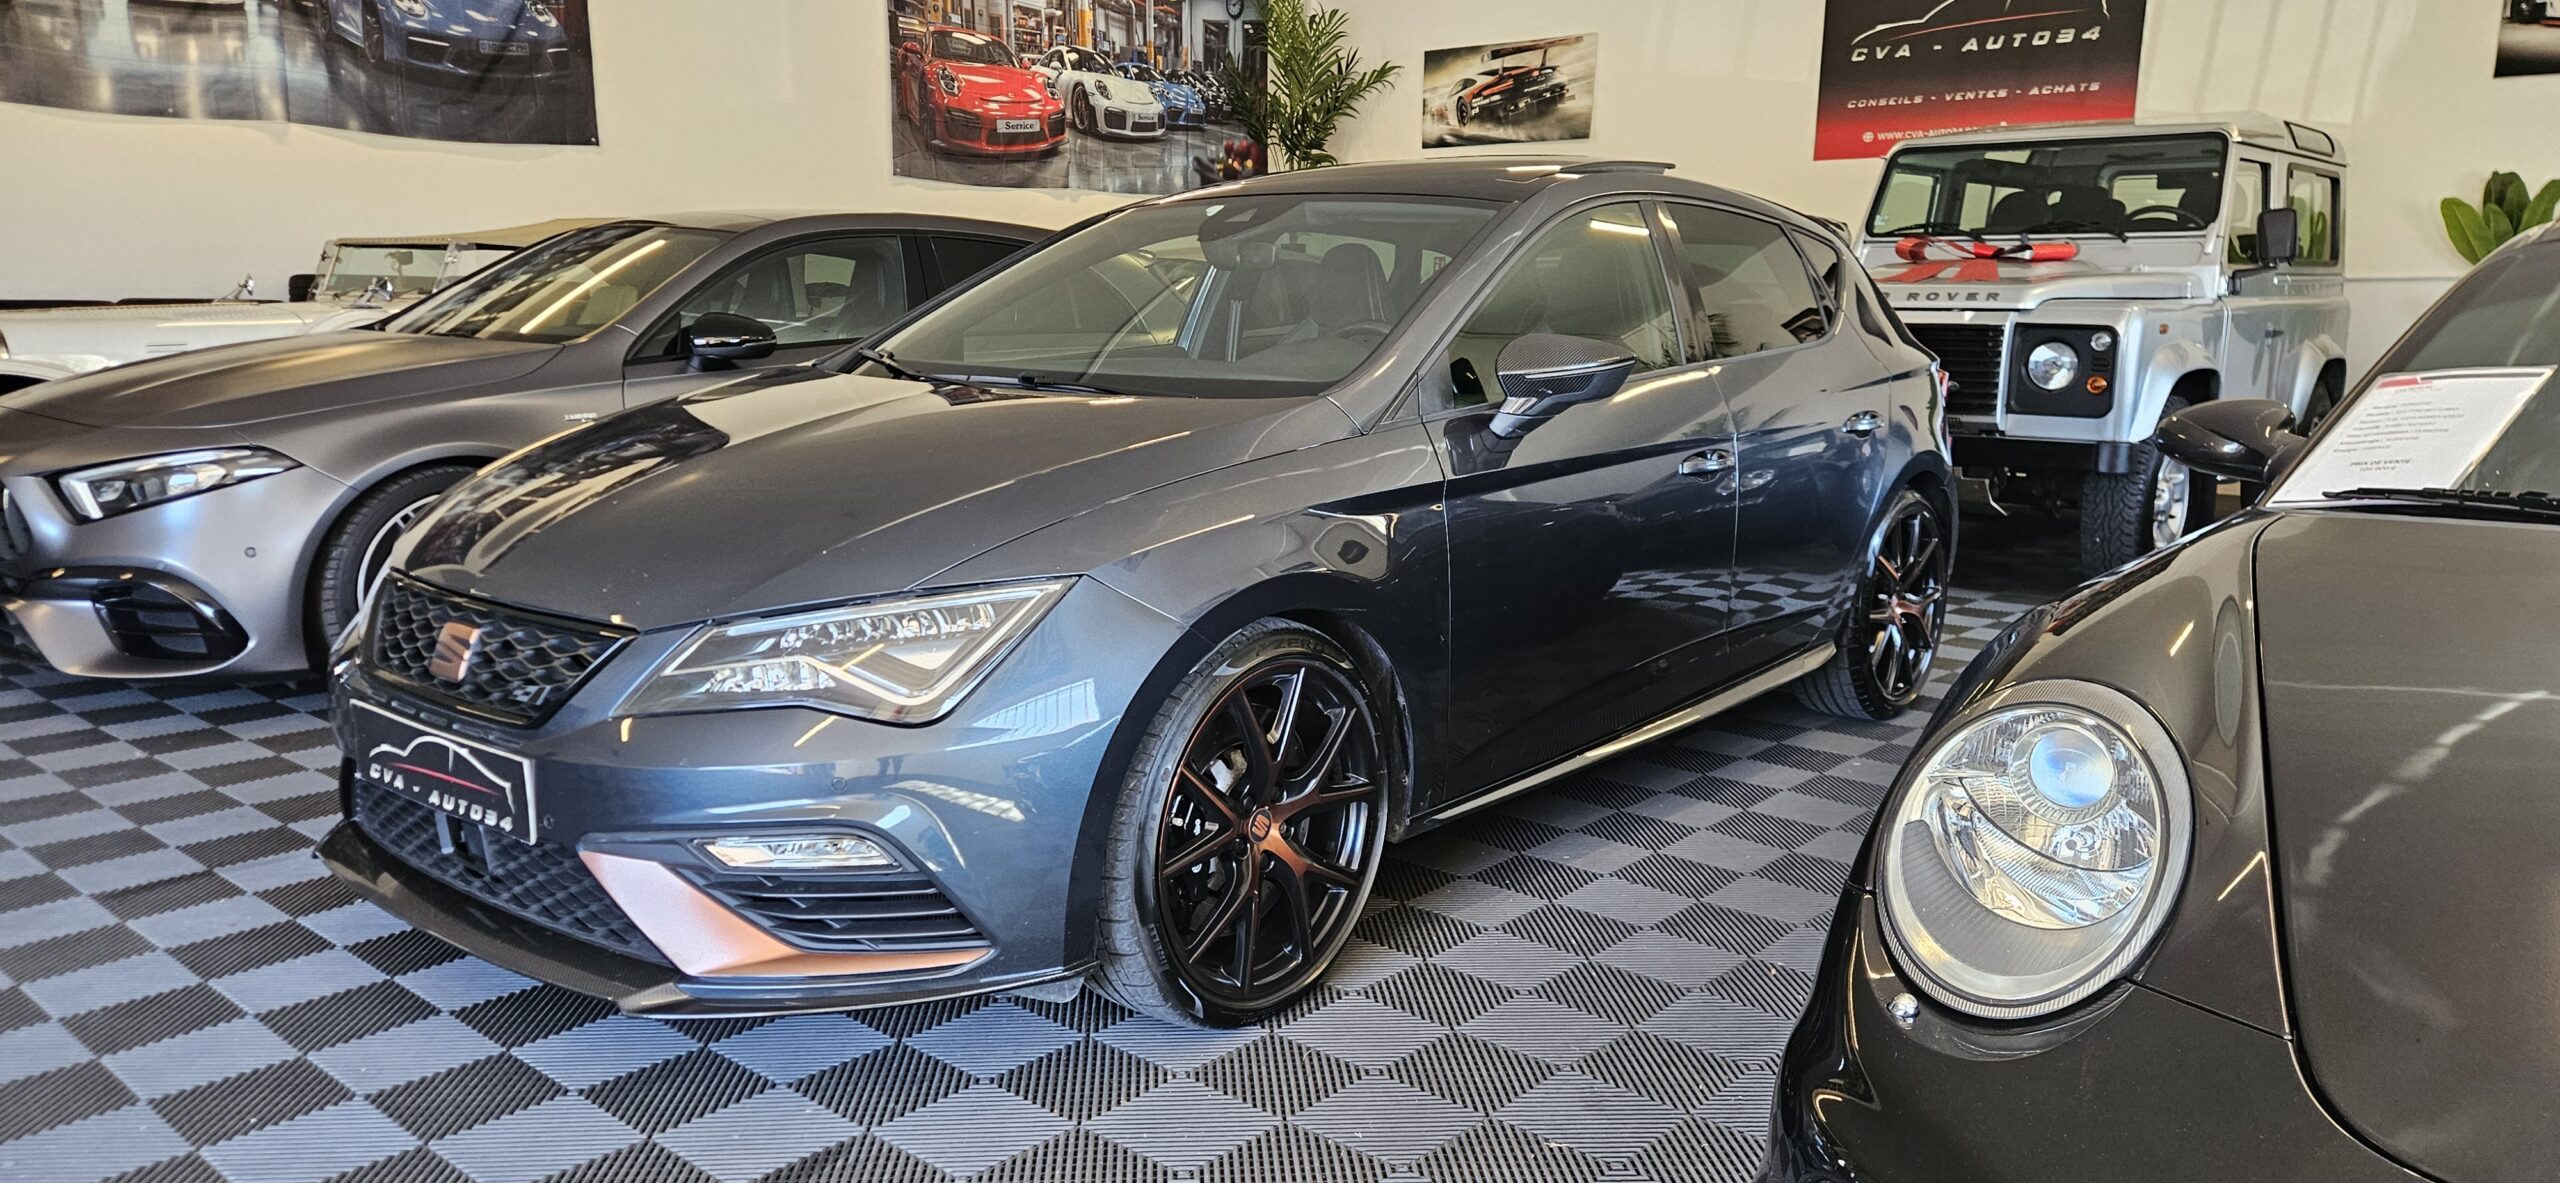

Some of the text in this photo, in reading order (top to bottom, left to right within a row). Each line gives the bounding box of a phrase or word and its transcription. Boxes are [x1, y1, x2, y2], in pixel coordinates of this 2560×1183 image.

[1851, 44, 1911, 62] CVA
[1961, 26, 2101, 52] AUTO34
[1847, 95, 1924, 109] CONSEILS
[1945, 89, 2009, 102] VENTES
[2028, 82, 2101, 96] ACHATS
[1004, 121, 1035, 130] Service
[1907, 292, 2000, 301] ROVER
[369, 763, 405, 790] CVA
[428, 790, 514, 832] AUTO34
